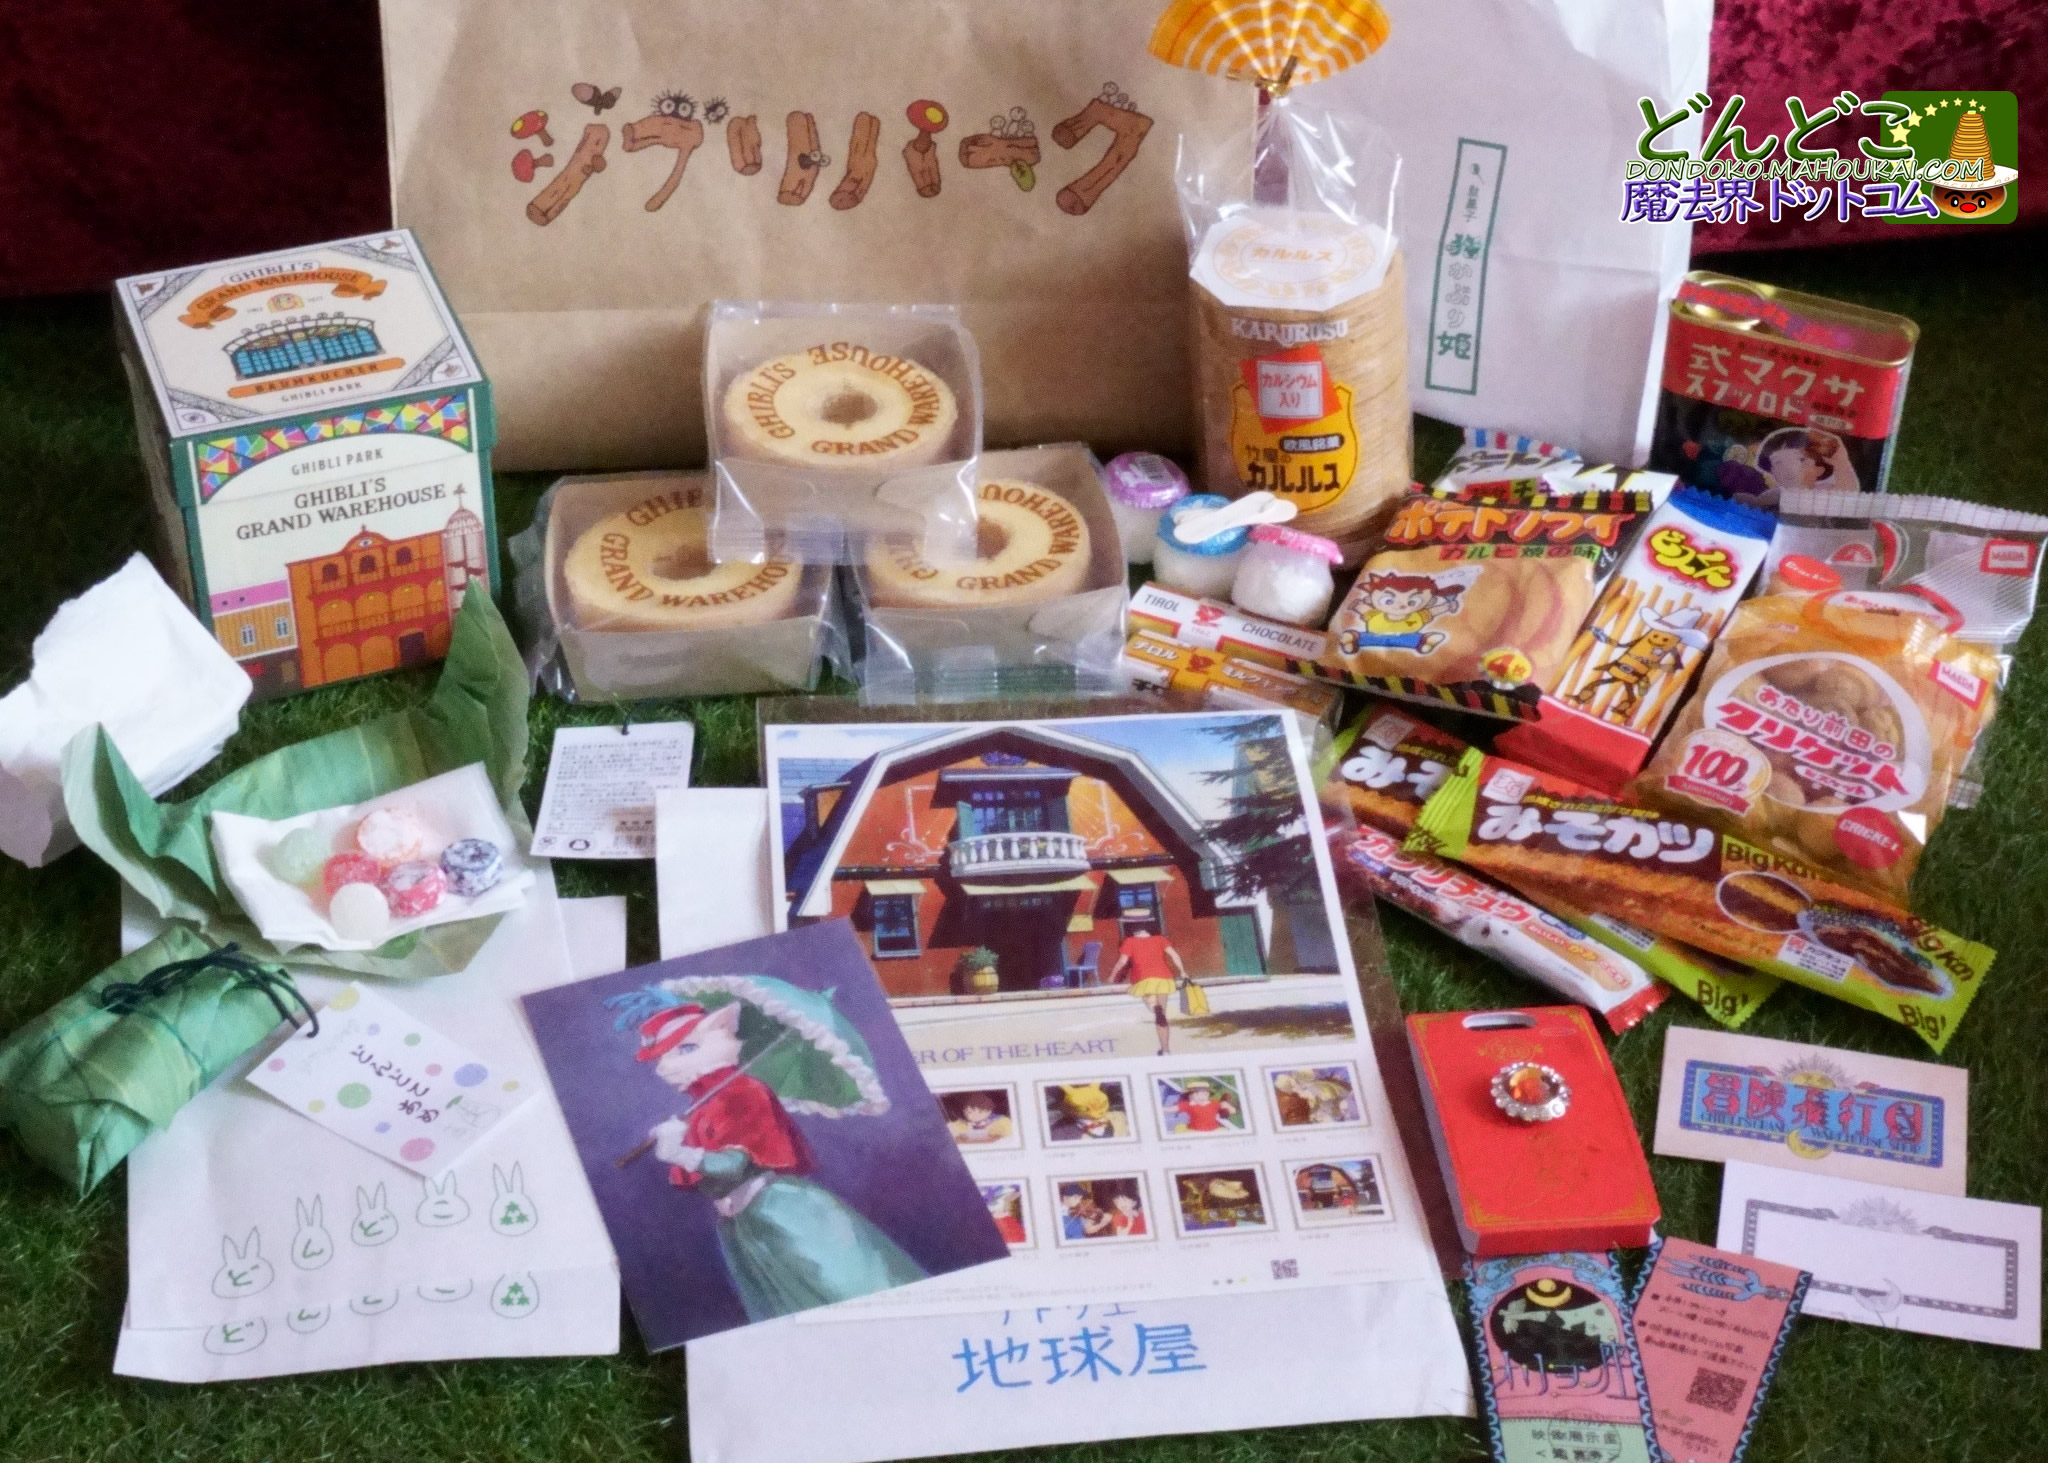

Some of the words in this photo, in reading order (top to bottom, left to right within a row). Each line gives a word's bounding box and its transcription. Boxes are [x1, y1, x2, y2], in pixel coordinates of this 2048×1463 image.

[510, 83, 1154, 226] ジブリパーク
[229, 261, 314, 284] GHIBLI'S
[1231, 317, 1349, 346] KARURUSU
[807, 340, 942, 428] WAREHOUSE
[1261, 372, 1318, 389] カルシウム
[746, 361, 797, 440] GHIBLI'S
[1279, 391, 1301, 408] 入り
[811, 429, 920, 456] GRAND
[291, 456, 340, 477] GHIBLI
[346, 448, 384, 469] PARK
[1246, 461, 1340, 493] カルルス
[293, 477, 387, 509] GHIBLI'S
[236, 513, 312, 541] GRAND
[320, 483, 447, 525] WAREHOUSE
[601, 533, 655, 602] GRAND
[956, 558, 1063, 590] GRAND
[1143, 594, 1180, 613] TIROL
[1241, 622, 1319, 653] CHOCOLATE
[1758, 686, 1896, 759] あたり前田の
[1478, 804, 1715, 864] みそカツ
[942, 1047, 975, 1063] OF
[980, 1043, 1031, 1060] THE
[1034, 1038, 1120, 1058] HEART
[397, 1099, 441, 1124] あめ
[951, 1322, 1207, 1394] 地球屋
